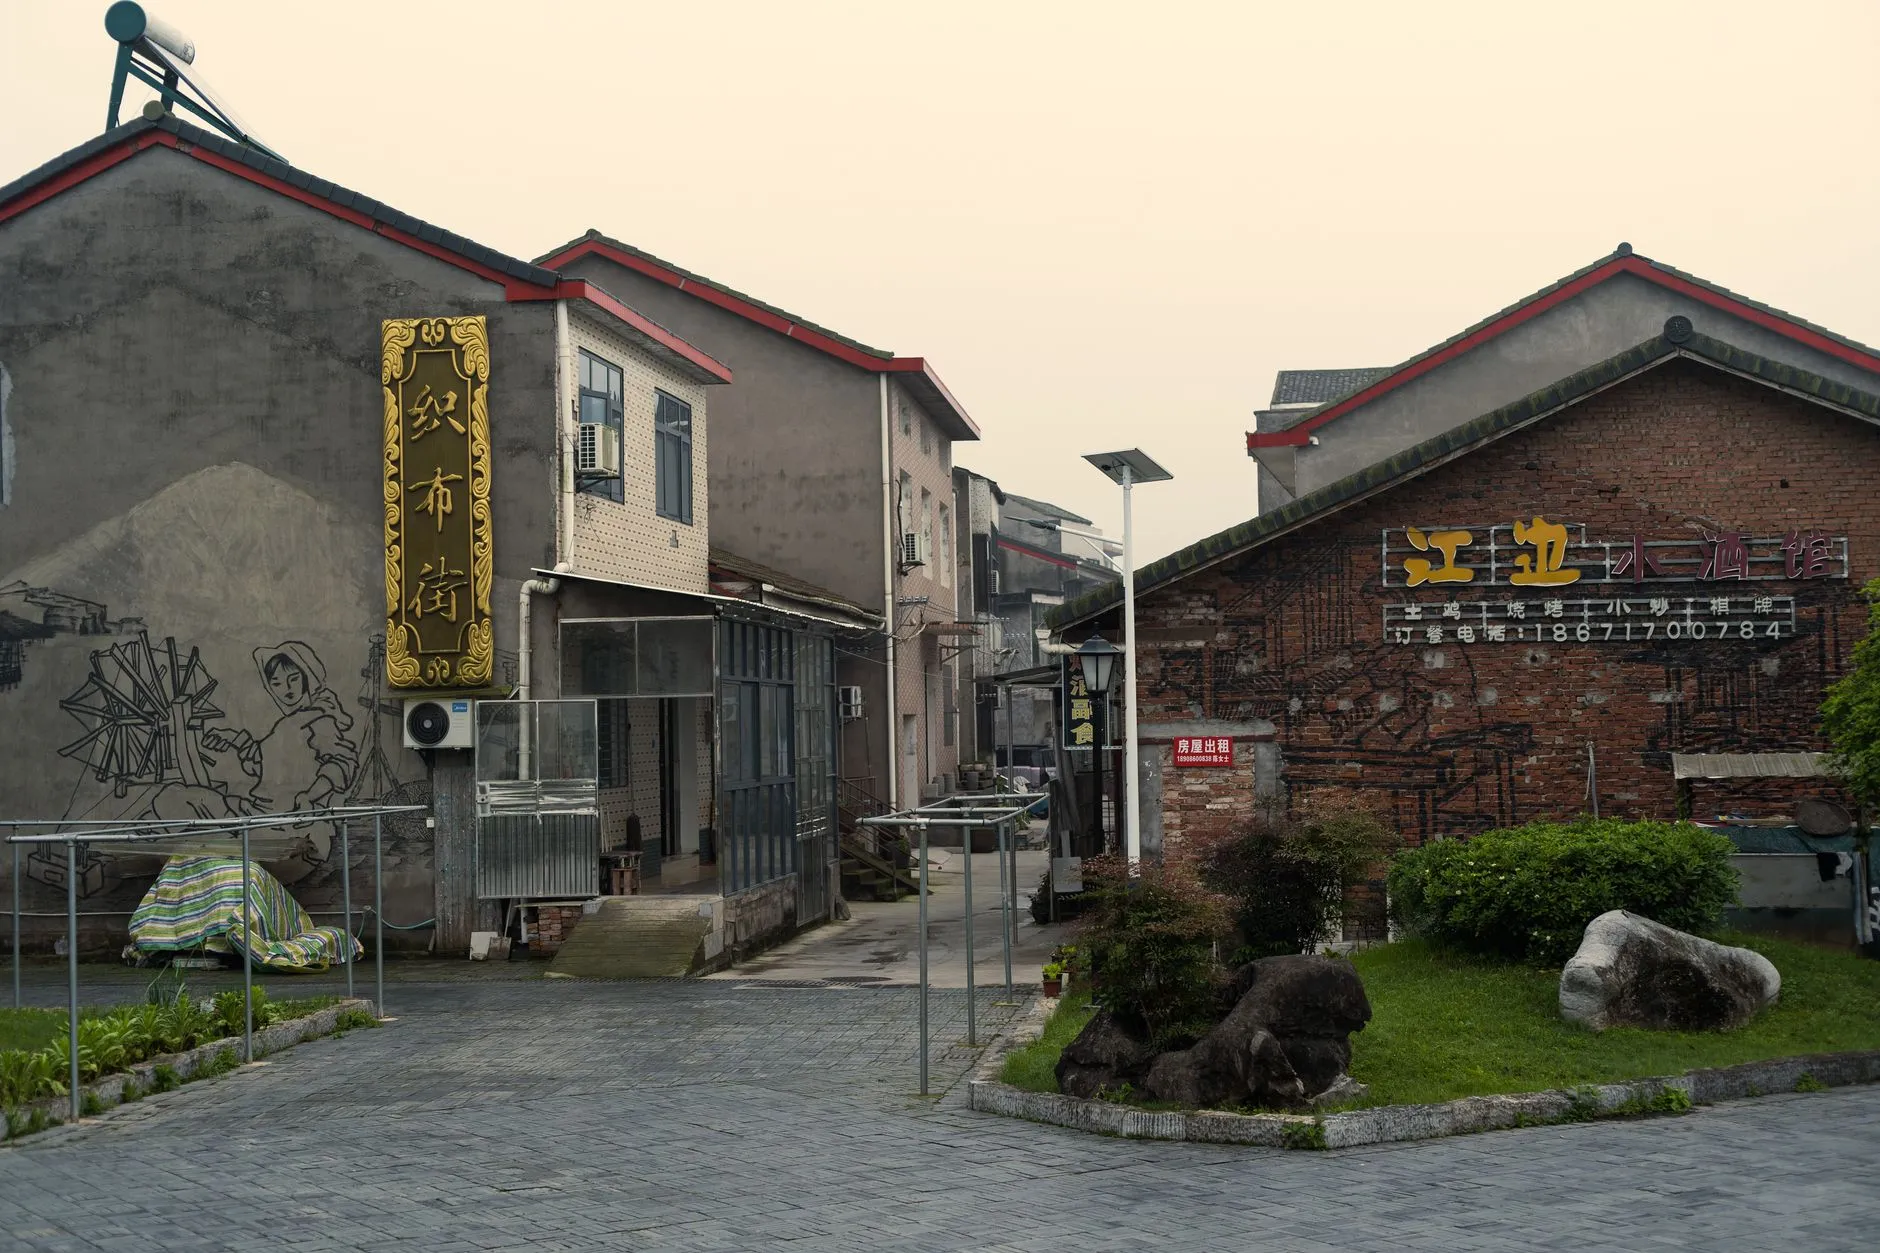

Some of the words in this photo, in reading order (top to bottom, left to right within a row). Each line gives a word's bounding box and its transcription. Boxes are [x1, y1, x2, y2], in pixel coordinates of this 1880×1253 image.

[407, 384, 468, 623] 织布街
[1404, 600, 1461, 620] 土鸡
[1507, 598, 1563, 619] 烧烤
[1710, 596, 1773, 615] 棋牌
[1177, 739, 1230, 753] 房屋出租
